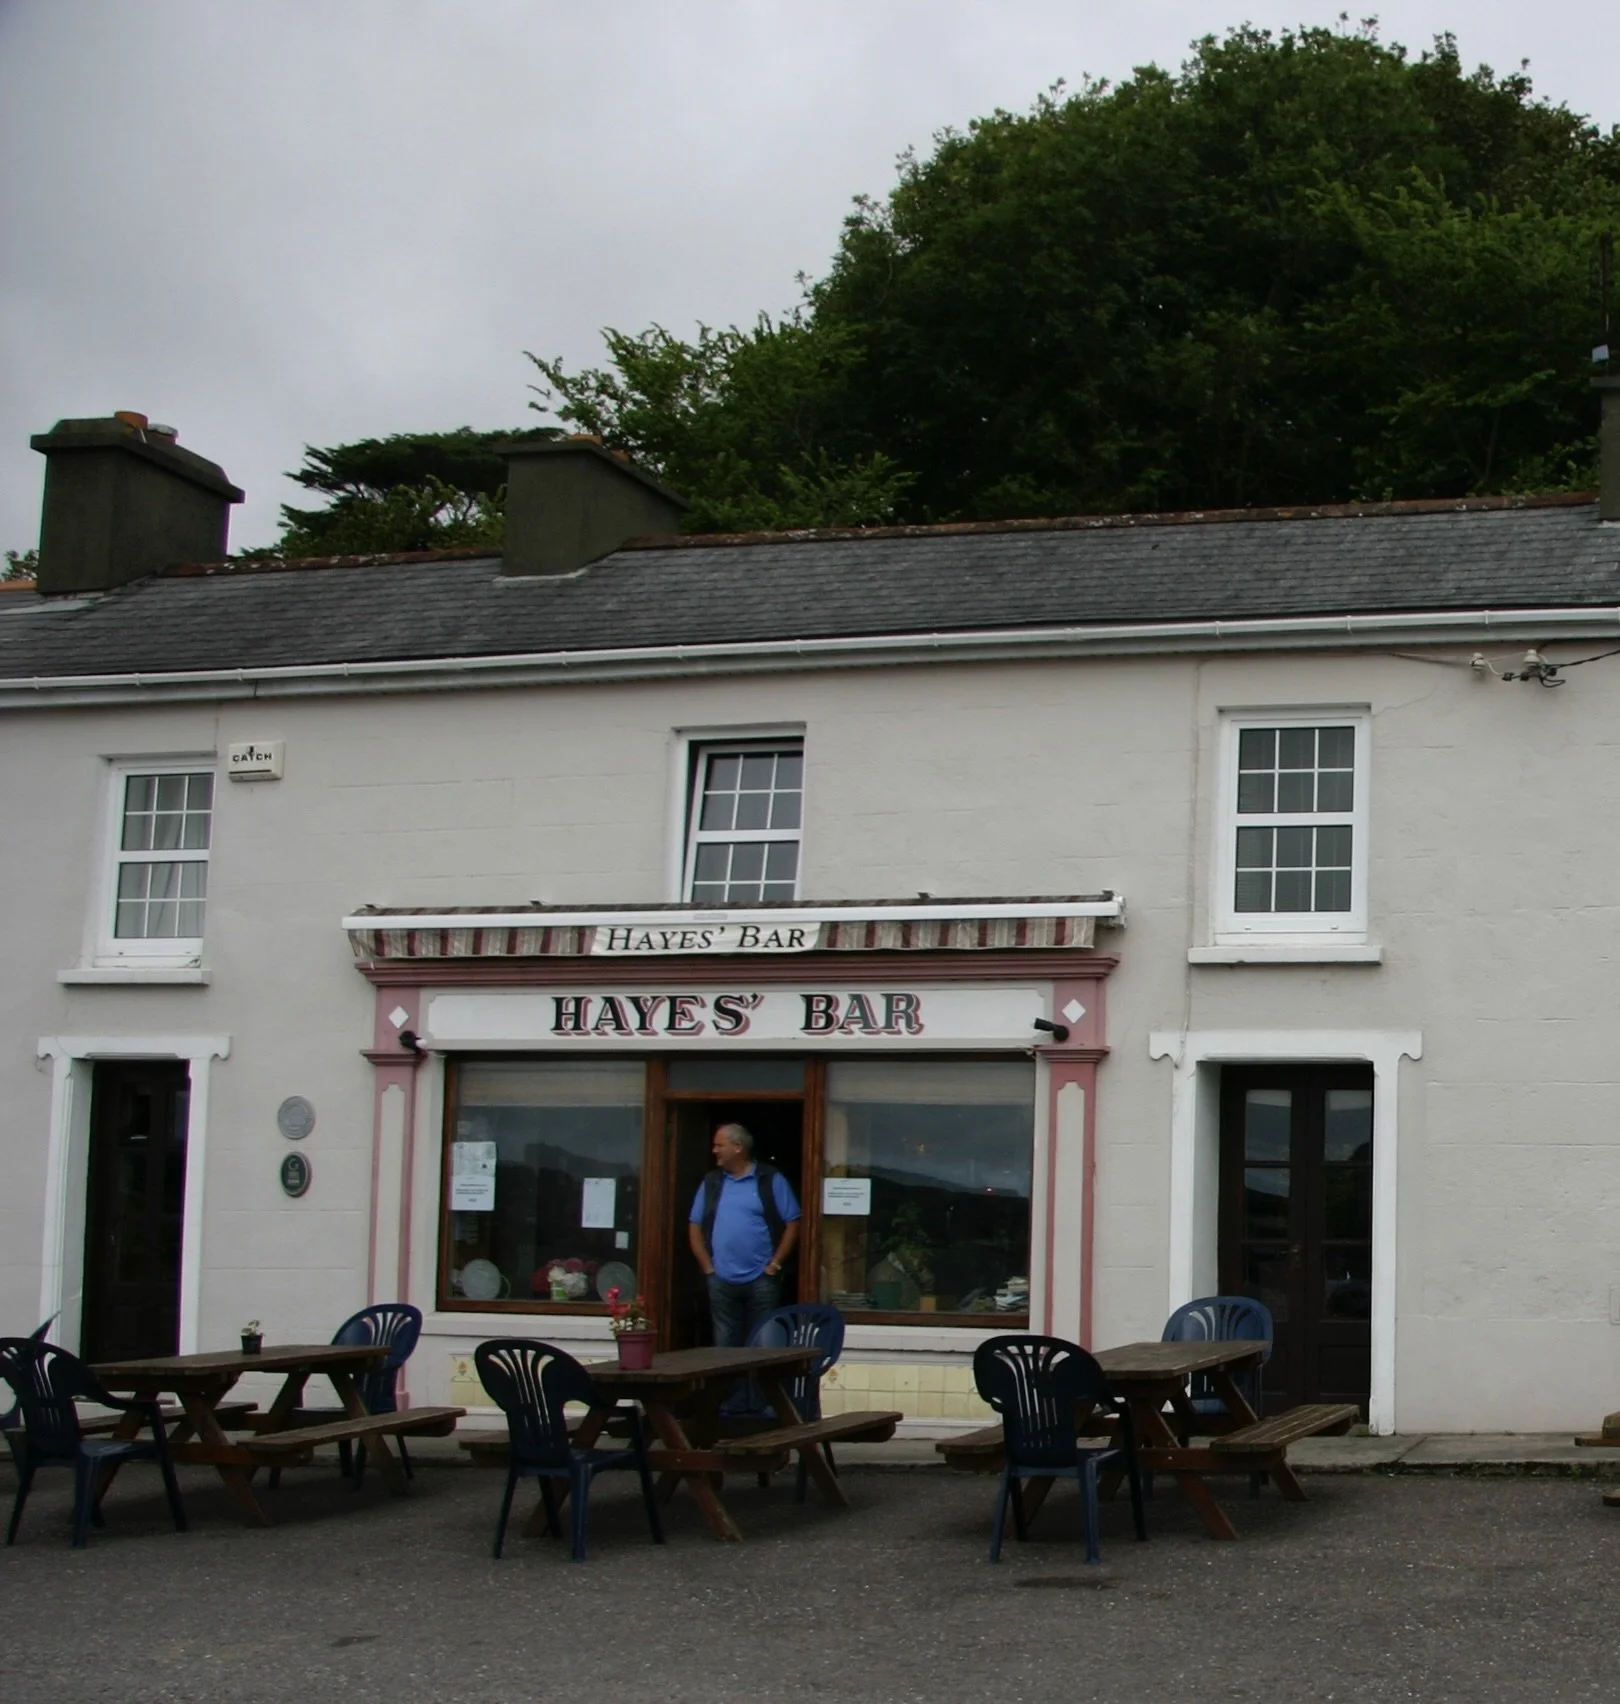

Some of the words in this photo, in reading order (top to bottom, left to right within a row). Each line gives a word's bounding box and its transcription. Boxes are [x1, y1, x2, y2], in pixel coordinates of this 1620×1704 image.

[232, 752, 273, 762] CATCH
[606, 926, 726, 951] HAYES'
[736, 925, 807, 948] BAR
[550, 993, 765, 1037] HAYES'
[799, 992, 925, 1036] BAR
